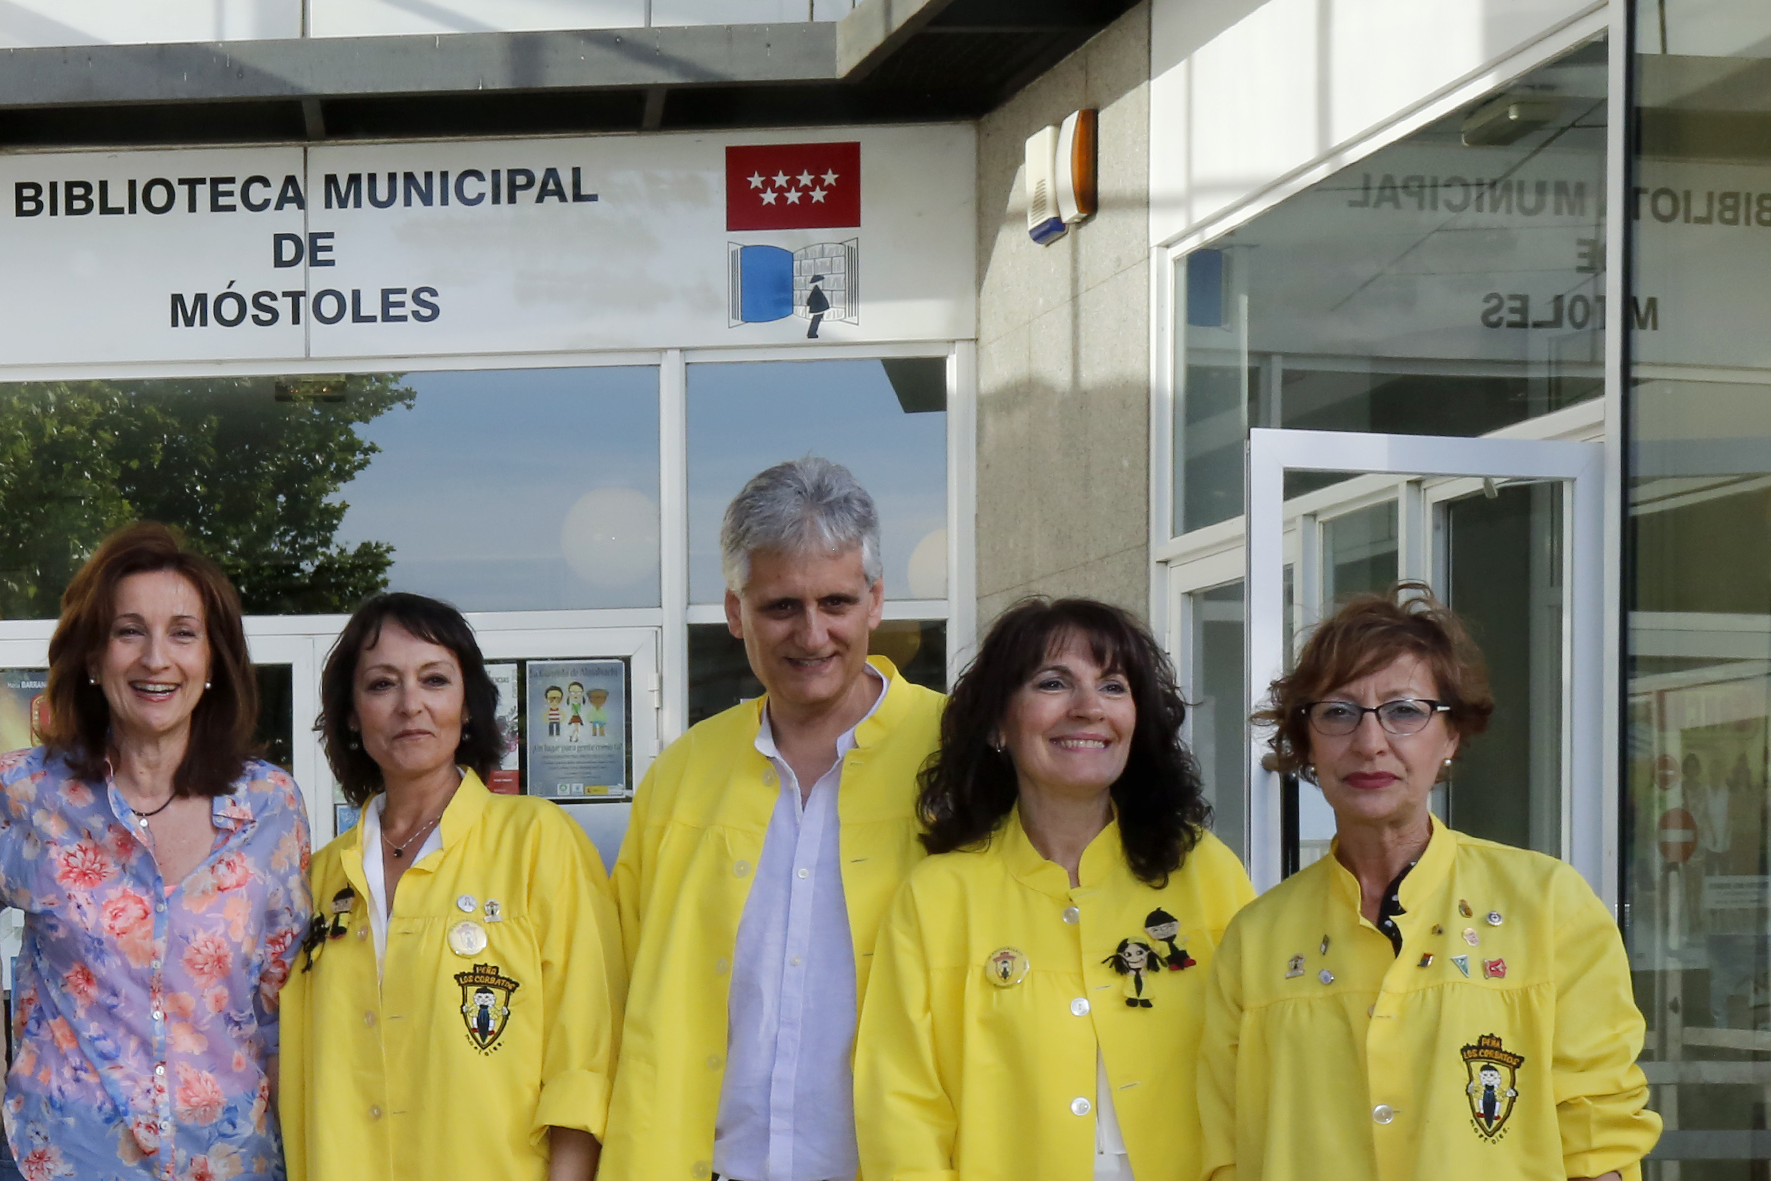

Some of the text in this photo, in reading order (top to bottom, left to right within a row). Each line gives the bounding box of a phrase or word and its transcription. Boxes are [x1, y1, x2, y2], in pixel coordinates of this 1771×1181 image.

[14, 167, 599, 217] BIBLIOTECA MUNICIPAL
[272, 232, 336, 268] DE
[170, 280, 441, 328] MÓSTOLES
[460, 976, 474, 984] LOS
[1464, 1049, 1478, 1058] LOS
